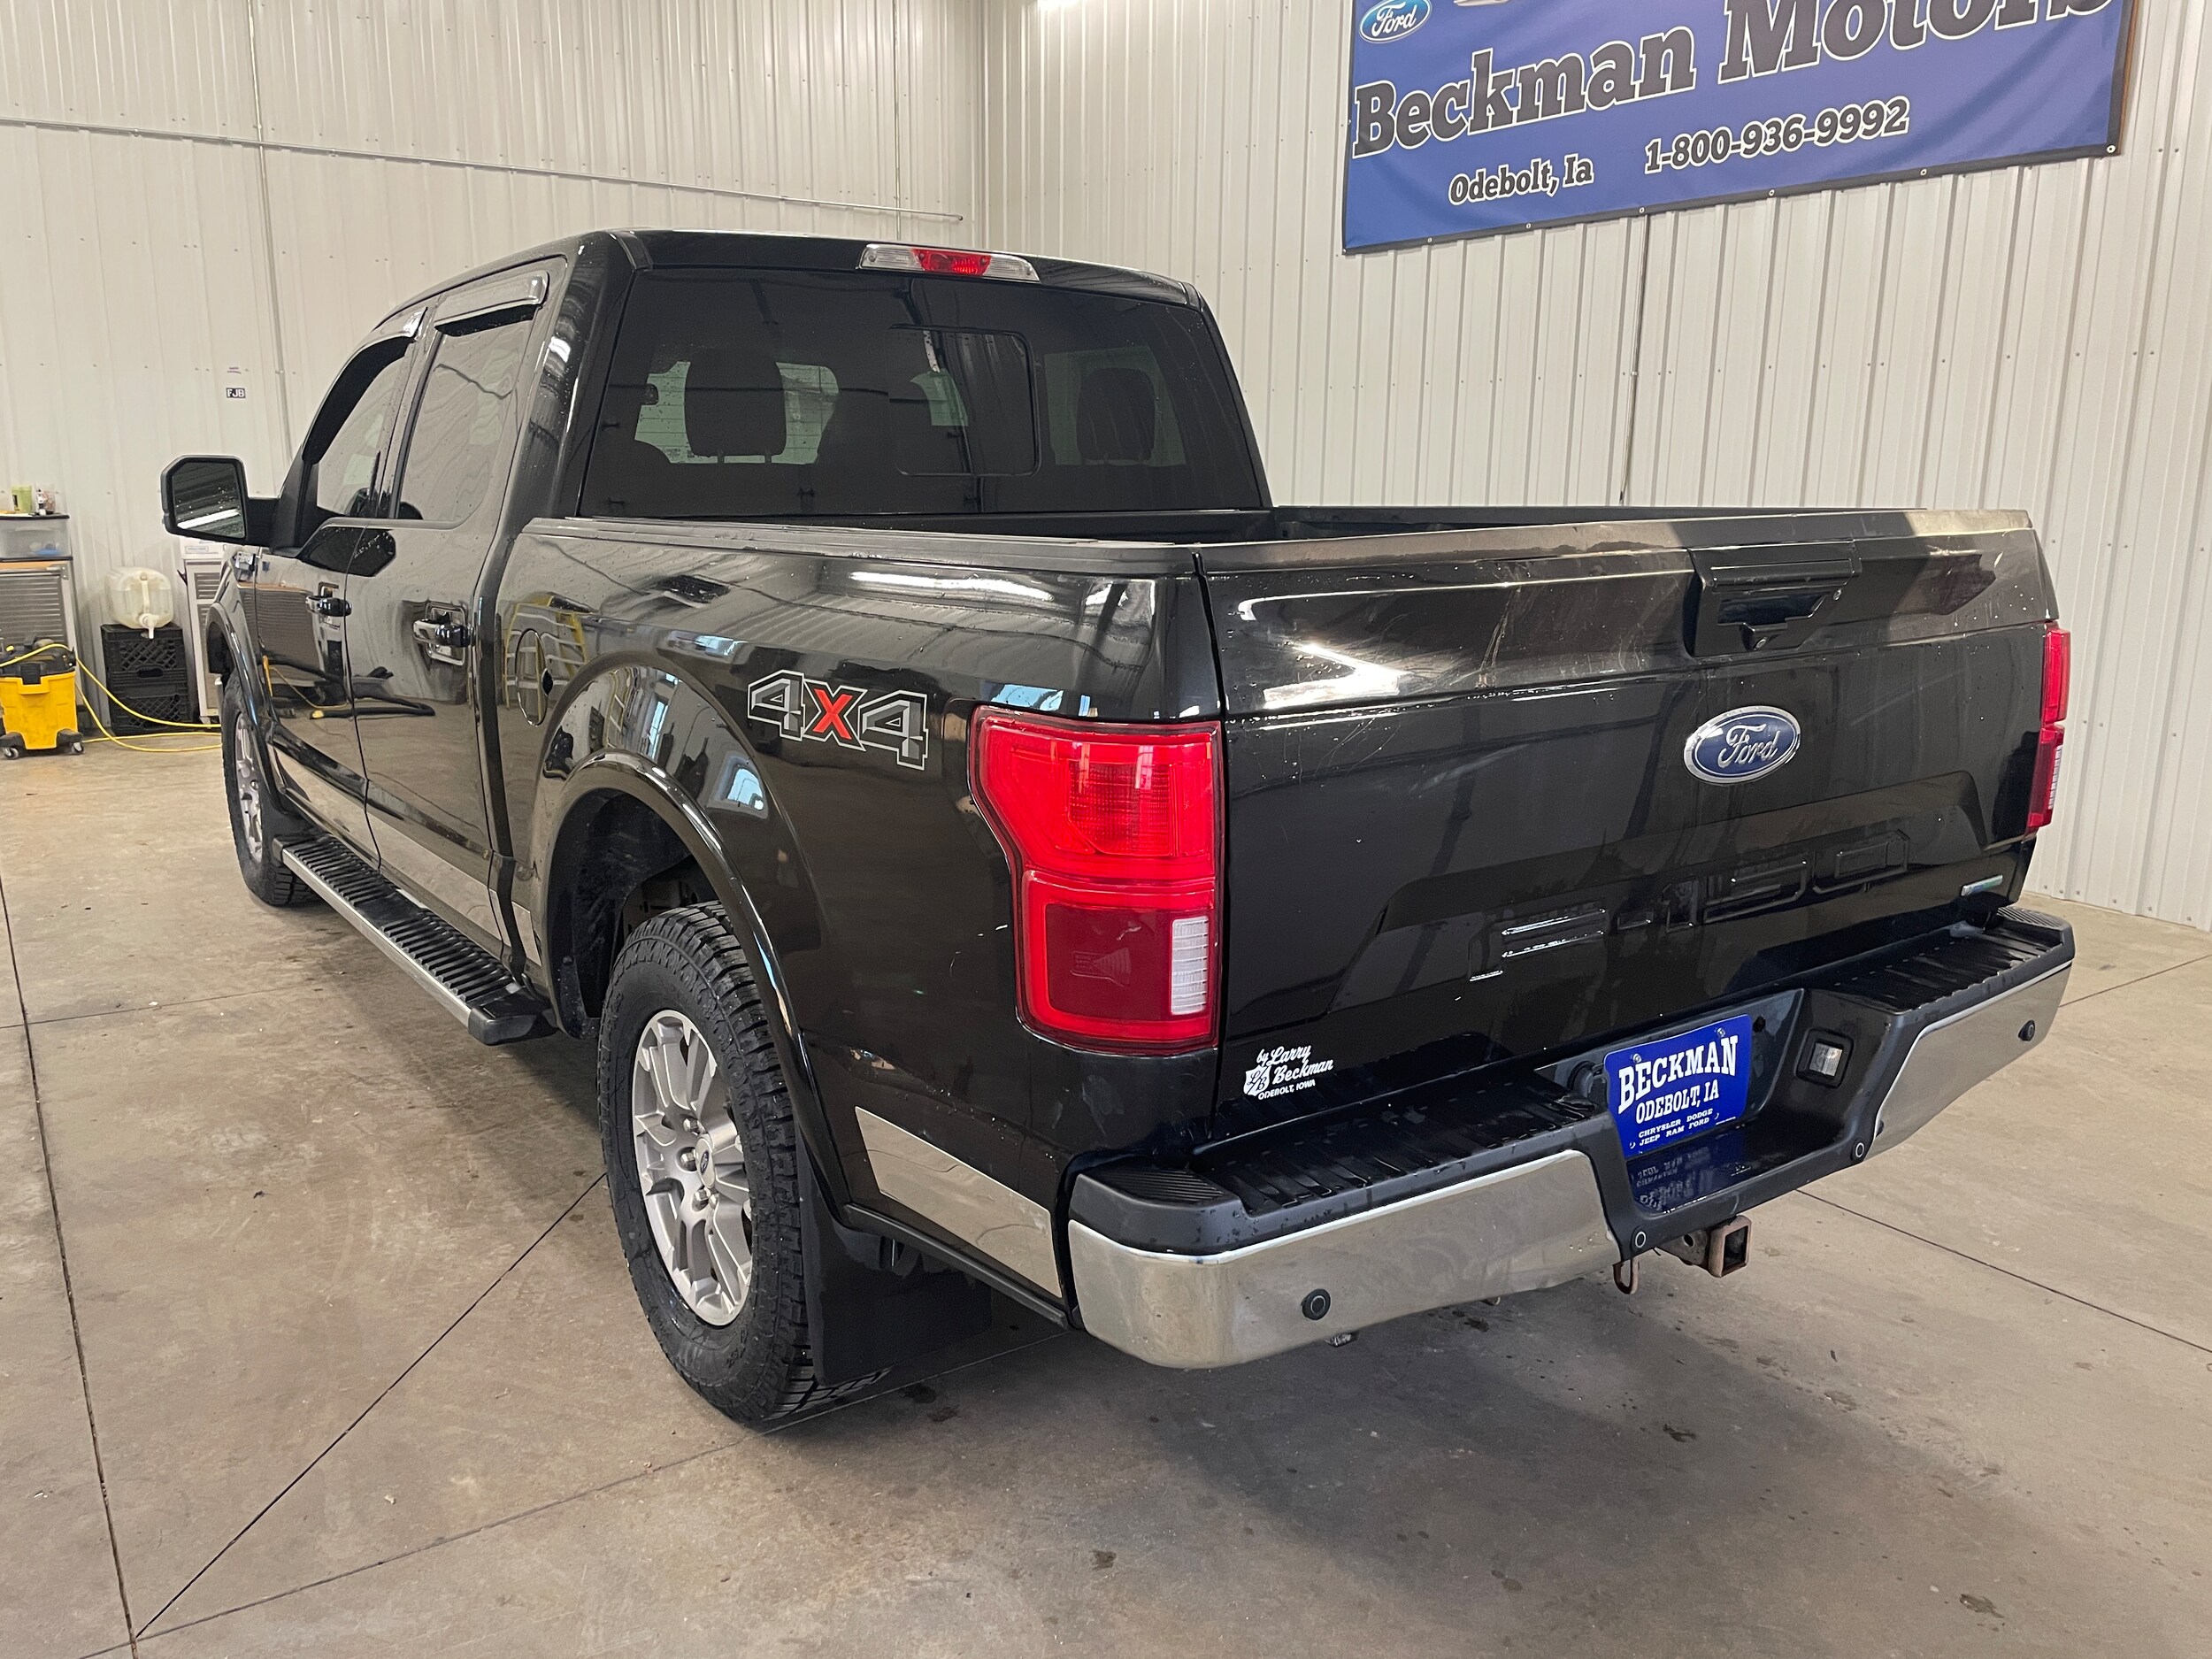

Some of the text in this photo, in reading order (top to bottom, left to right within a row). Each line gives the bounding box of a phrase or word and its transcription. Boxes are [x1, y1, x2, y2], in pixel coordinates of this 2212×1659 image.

[1371, 1, 1417, 37] Ford
[1353, 0, 2112, 159] Beckman Moto
[1645, 96, 1910, 174] 1-800-936-9992
[1448, 153, 1594, 205] Odebolt, Ia
[227, 388, 245, 398] FJB
[748, 670, 928, 771] 4X4
[1717, 724, 1781, 768] Ford
[1256, 1045, 1311, 1066] by Larry
[1272, 1059, 1334, 1085] Beckman
[1618, 1035, 1738, 1114] BECKMAN
[1296, 1079, 1316, 1090] IOWA
[1636, 1079, 1719, 1124] ODEBOLT, IA
[1639, 1109, 1713, 1138] CHRYSLER DODGE
[1640, 1118, 1709, 1146] JEEP RAM FORD
